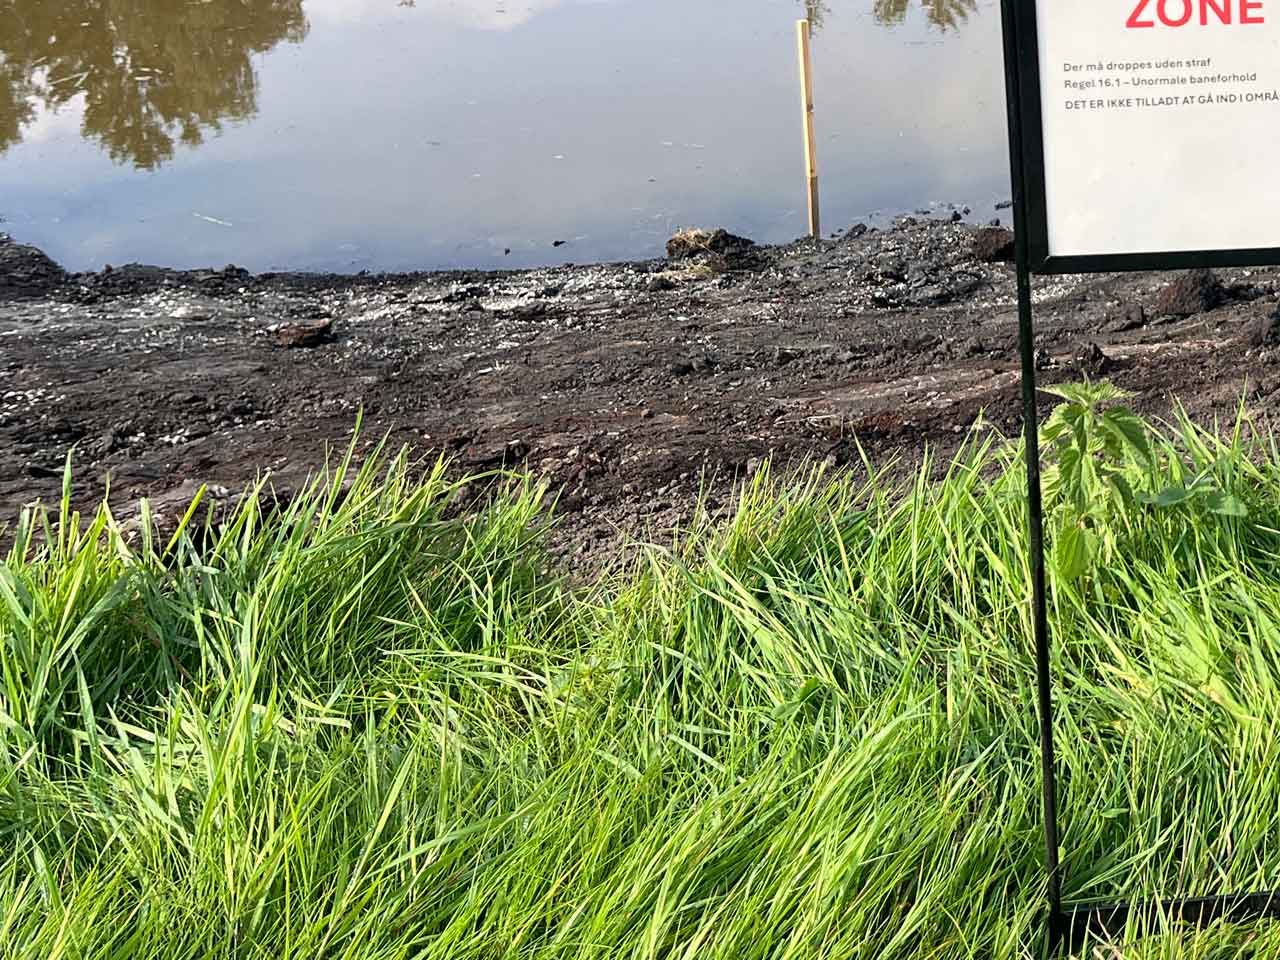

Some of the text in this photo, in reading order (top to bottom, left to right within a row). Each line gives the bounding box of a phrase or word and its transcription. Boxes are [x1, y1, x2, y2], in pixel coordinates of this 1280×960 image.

[1063, 57, 1212, 73] Der må droppes uden straf
[1063, 79, 1096, 91] Regel
[1097, 77, 1121, 88] 16.1
[1131, 76, 1188, 87] Unormale
[1189, 73, 1257, 85] baneforhold
[1064, 100, 1088, 110] DET
[1089, 99, 1105, 109] ER
[1106, 98, 1133, 109] IKKE
[1135, 96, 1180, 108] TILLADT
[1181, 95, 1197, 105] AT
[1197, 92, 1214, 105] GÅ
[1215, 93, 1238, 104] IND
